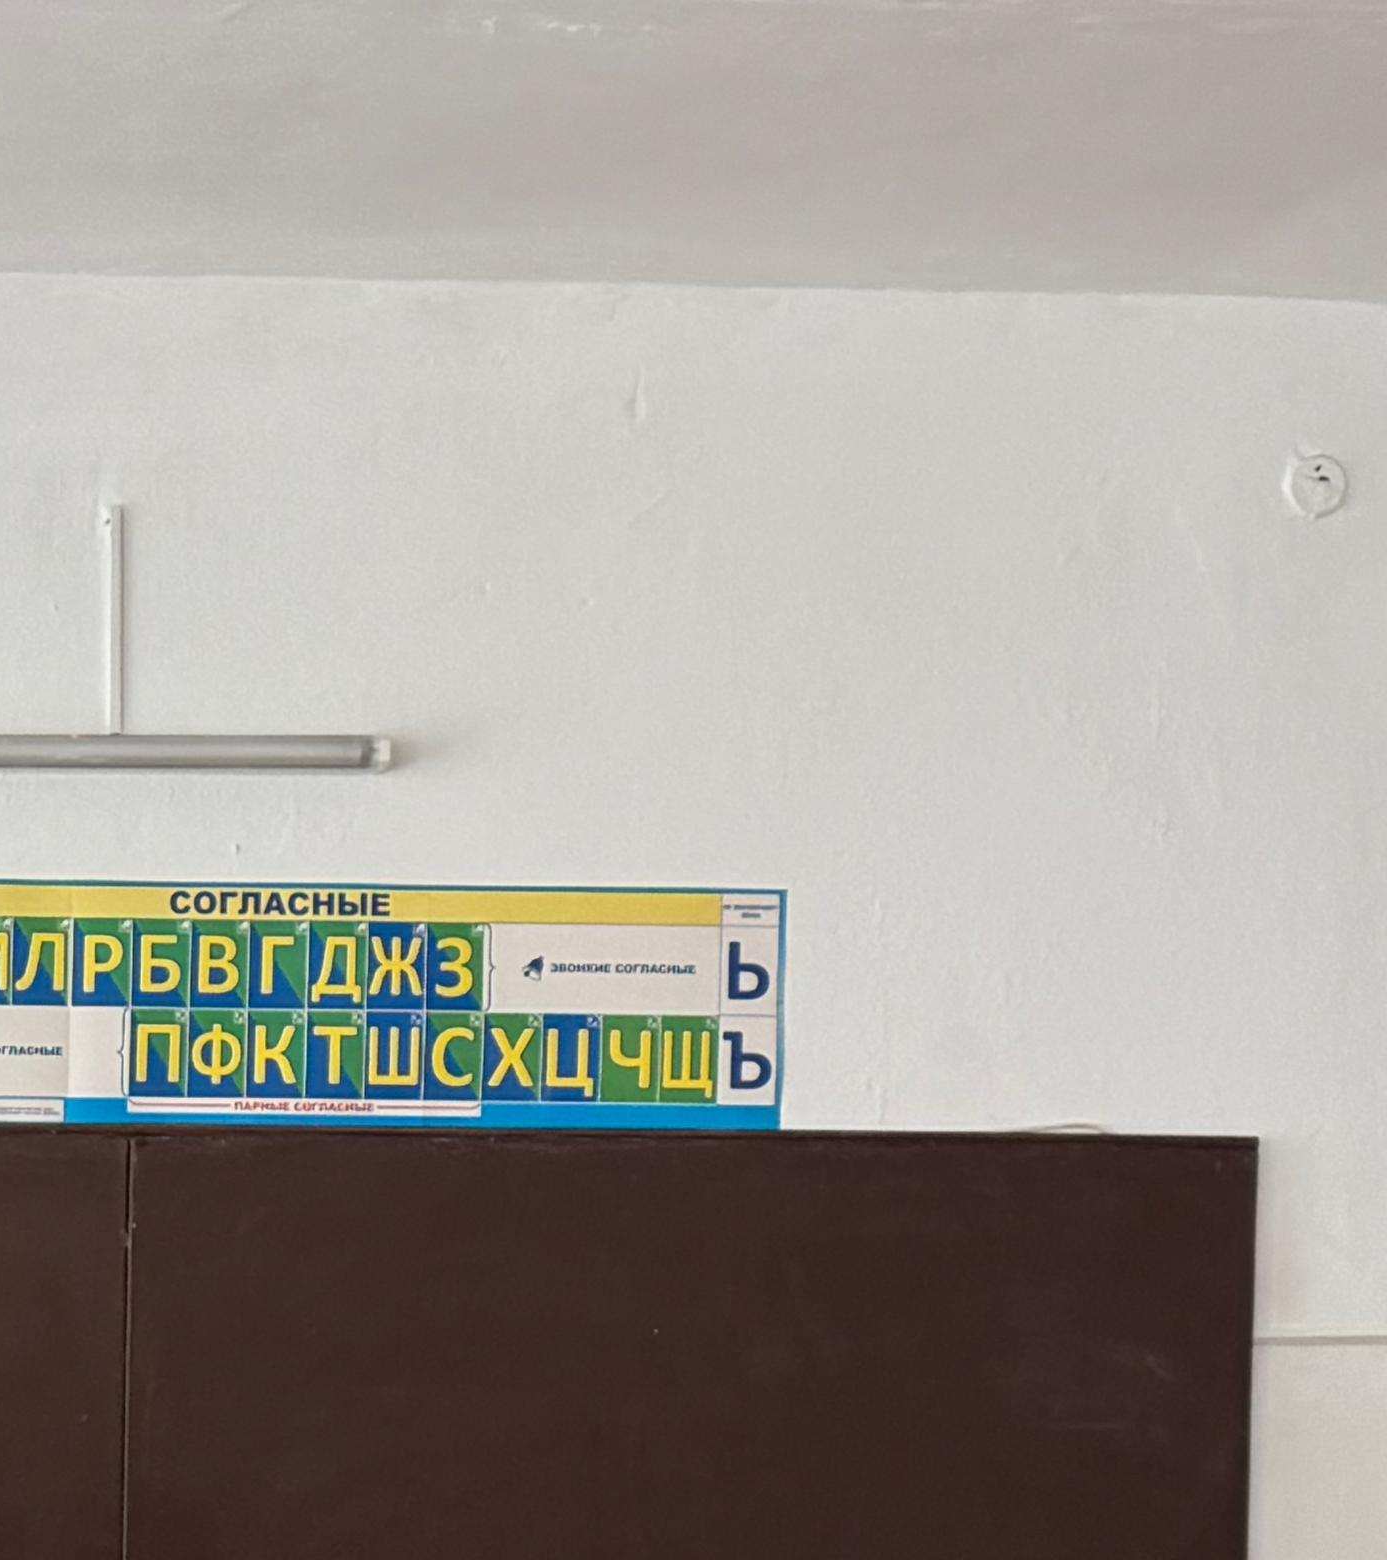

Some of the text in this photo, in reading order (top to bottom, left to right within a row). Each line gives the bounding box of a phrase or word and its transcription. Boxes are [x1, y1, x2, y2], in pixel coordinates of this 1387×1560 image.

[169, 890, 391, 918] СОГЛАСНЫЕ
[614, 963, 696, 975] СОГЛАСНЫЕ
[727, 941, 769, 1000] Ь
[722, 1031, 772, 1090] Ъ
[234, 1101, 375, 1113] ПАРНЫЕ СОГЛАСНЫЕ
